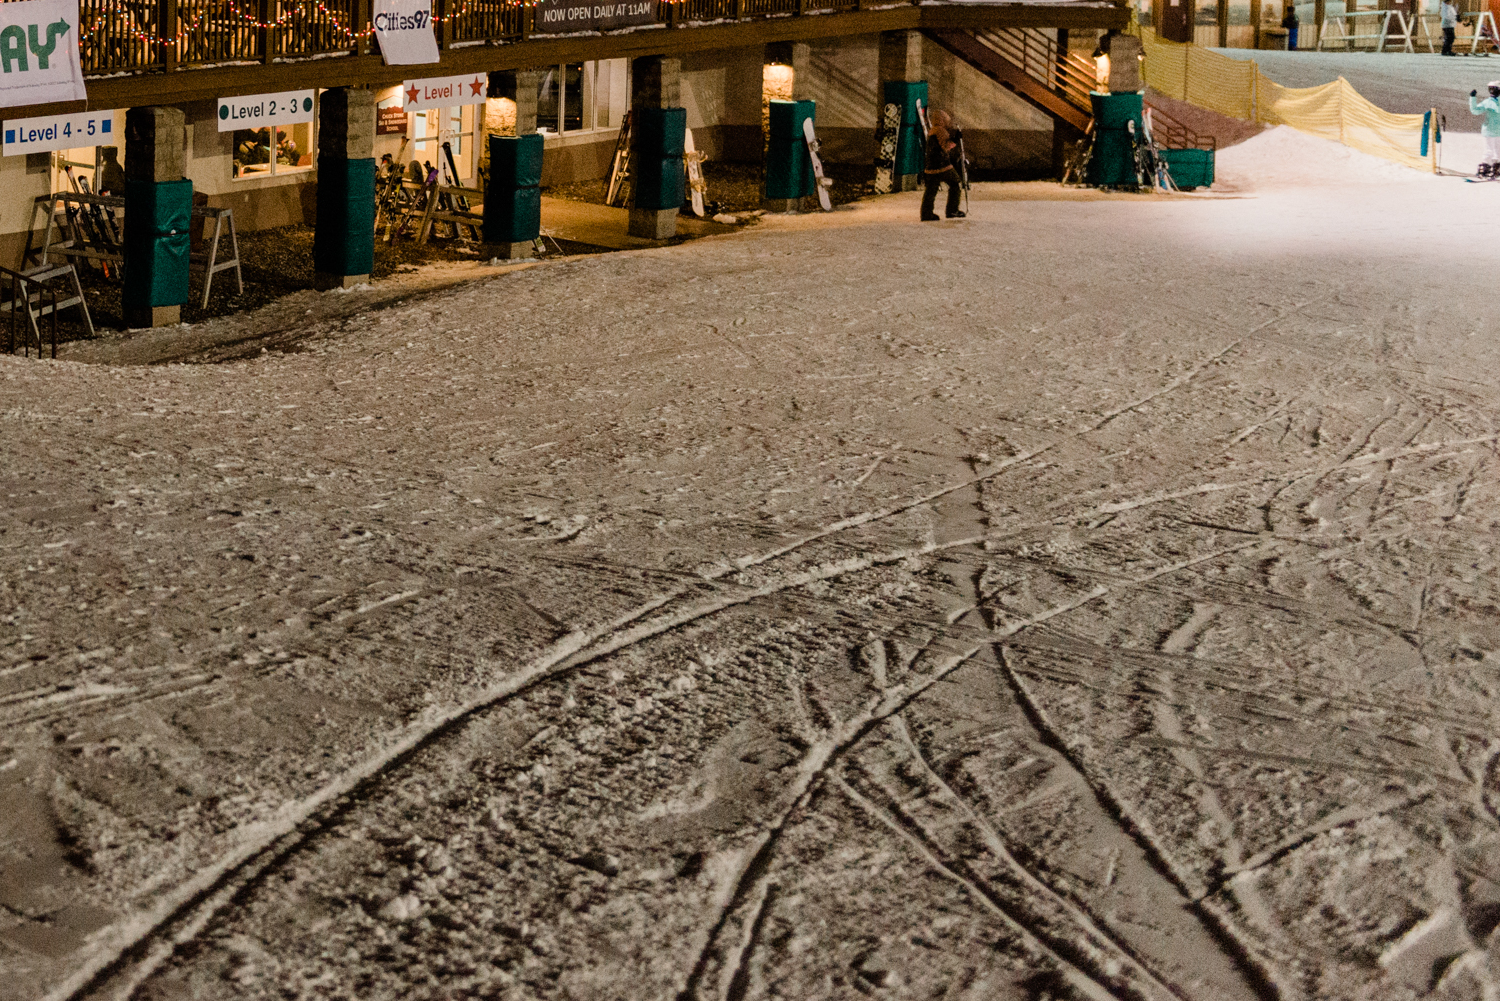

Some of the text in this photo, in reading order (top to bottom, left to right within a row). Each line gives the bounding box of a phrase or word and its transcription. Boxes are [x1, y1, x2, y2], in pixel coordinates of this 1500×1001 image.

[375, 10, 430, 32] Cities97
[544, 2, 651, 22] NOW OPEN DAILY AT 11AM
[424, 82, 463, 100] Level 1
[231, 102, 264, 119] Level
[269, 100, 277, 116] 2
[290, 98, 298, 114] 3
[19, 123, 57, 143] Level
[63, 122, 72, 138] 4
[87, 120, 96, 136] 5
